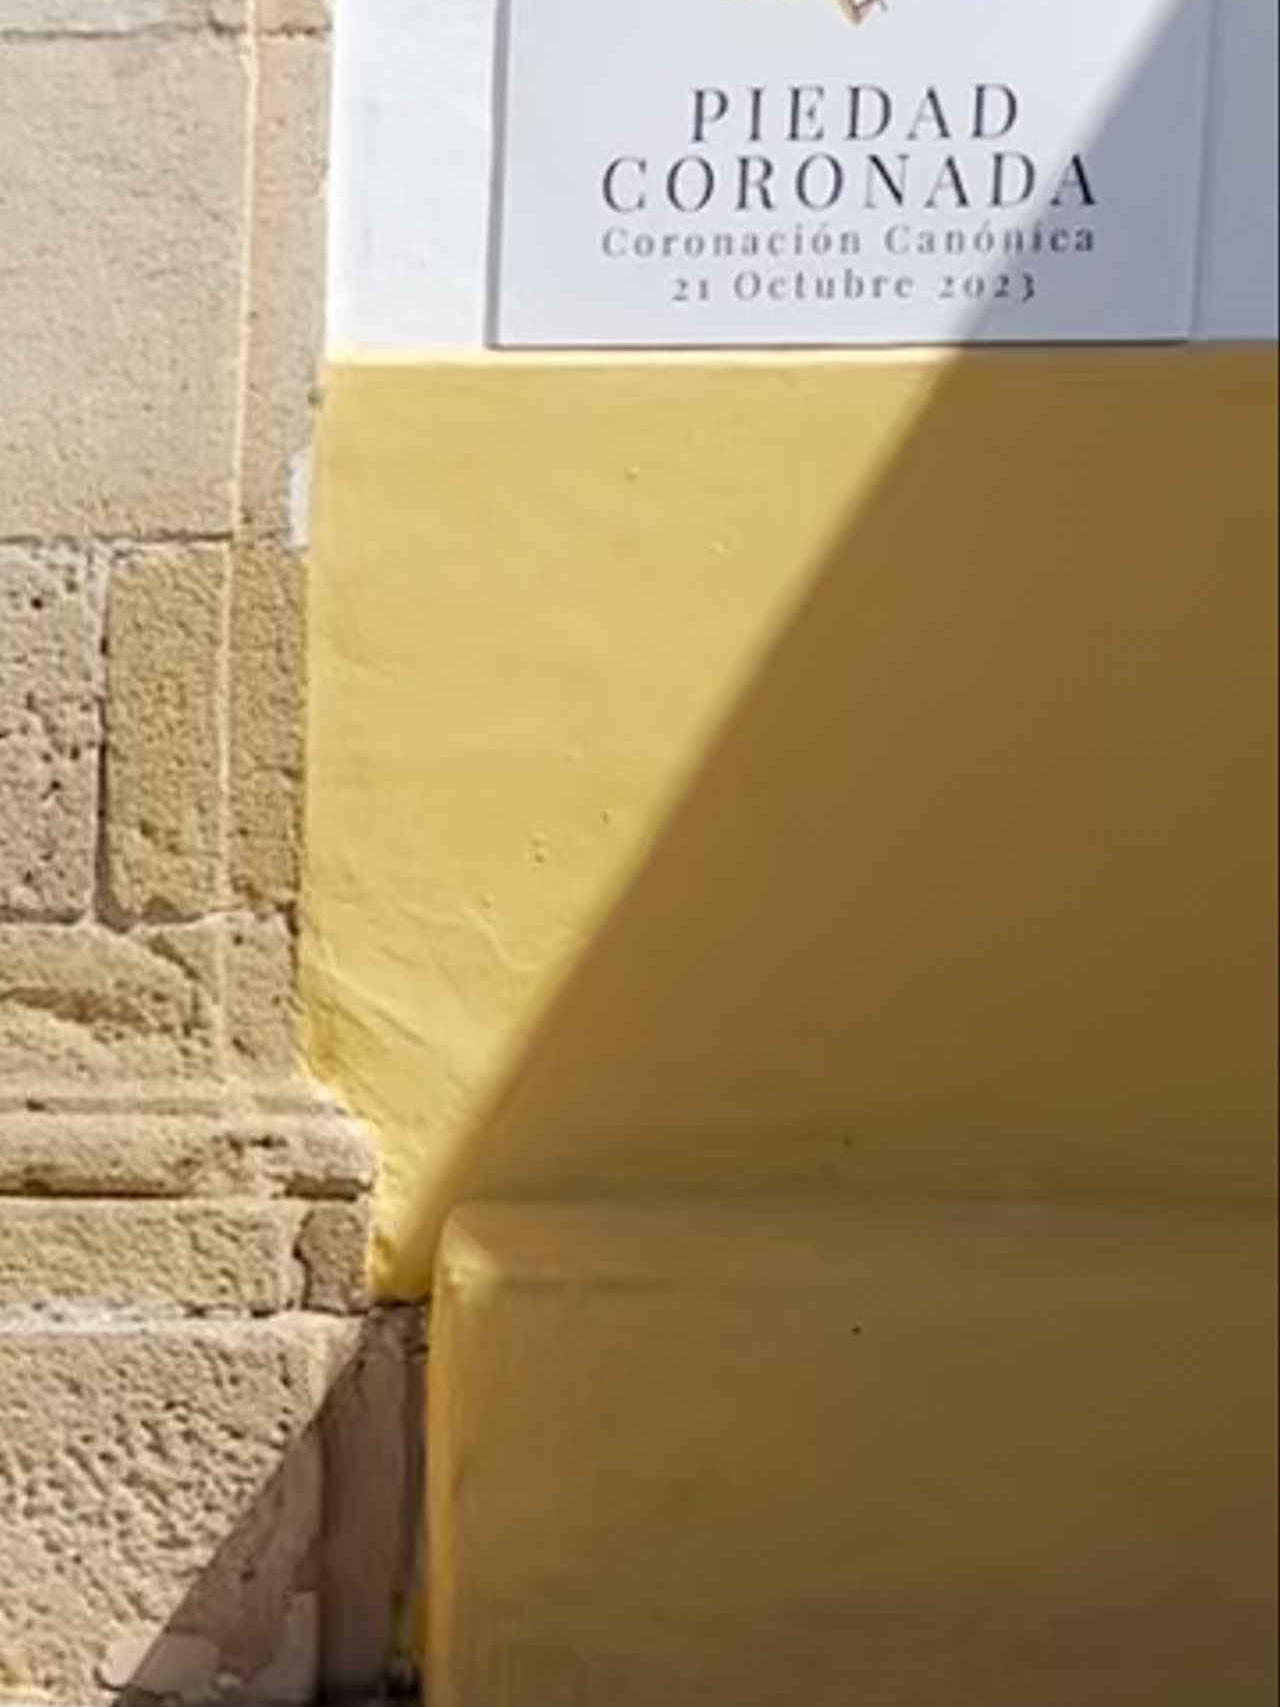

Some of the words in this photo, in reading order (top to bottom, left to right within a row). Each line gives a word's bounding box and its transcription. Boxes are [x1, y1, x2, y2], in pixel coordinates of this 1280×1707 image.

[690, 83, 1018, 143] PIEDAD
[602, 151, 1098, 213] CORONADA
[601, 222, 861, 257] Coronación
[883, 219, 1095, 256] Canónica
[671, 277, 710, 301] 21
[734, 267, 913, 301] Octubre
[938, 272, 1036, 303] 2023
